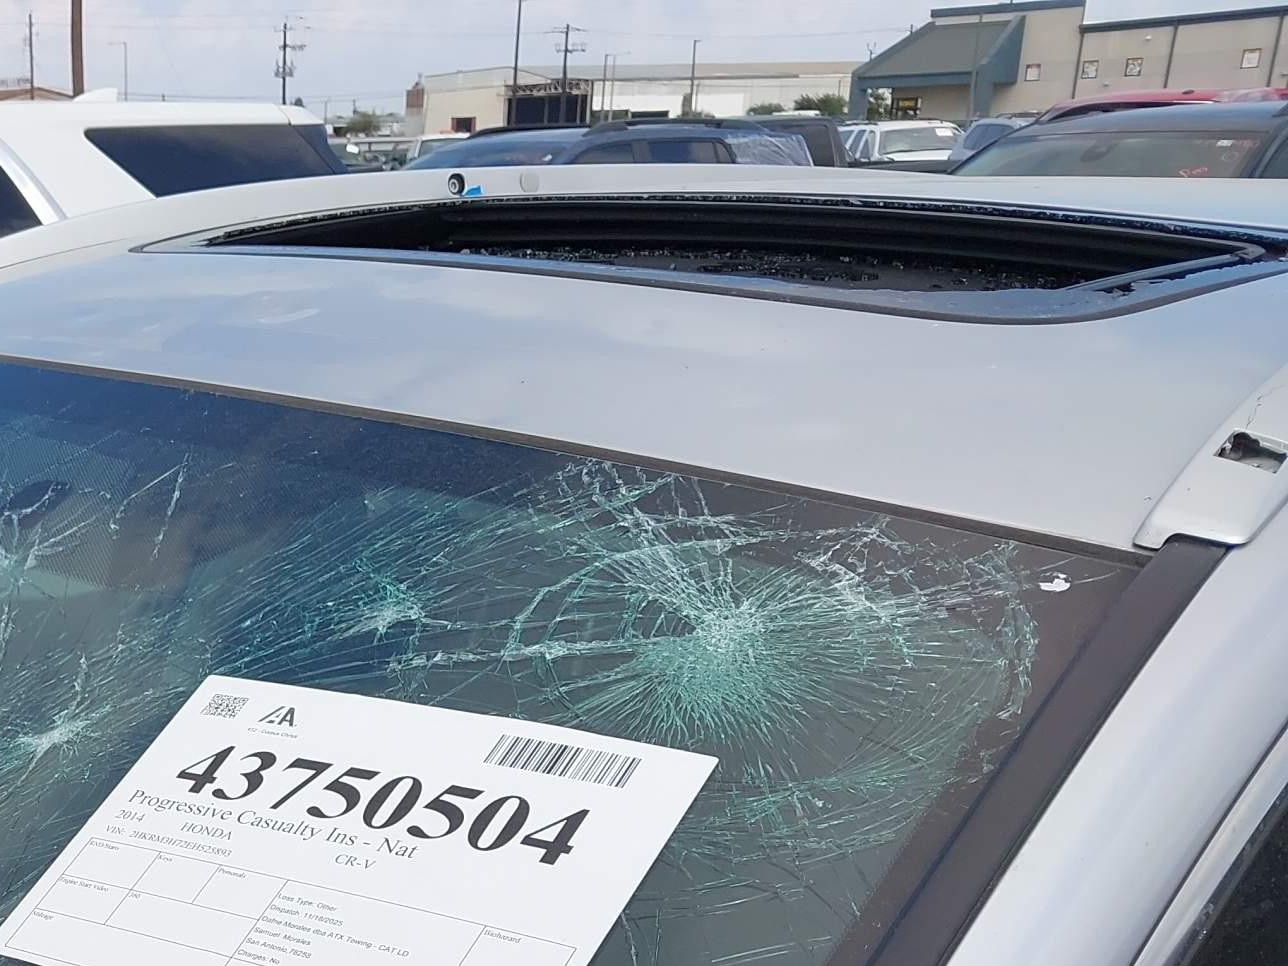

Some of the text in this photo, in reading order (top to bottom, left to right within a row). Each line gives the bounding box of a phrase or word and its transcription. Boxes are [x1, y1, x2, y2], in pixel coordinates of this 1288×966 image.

[105, 824, 126, 835] VIN:
[128, 789, 233, 821] Progressive
[237, 810, 322, 841] Casualty
[325, 827, 358, 846] Ins
[376, 837, 419, 859] Nat
[175, 745, 591, 866] 43750504
[114, 809, 376, 870] 2014 HONDA CR-V
[283, 921, 311, 933] Morales
